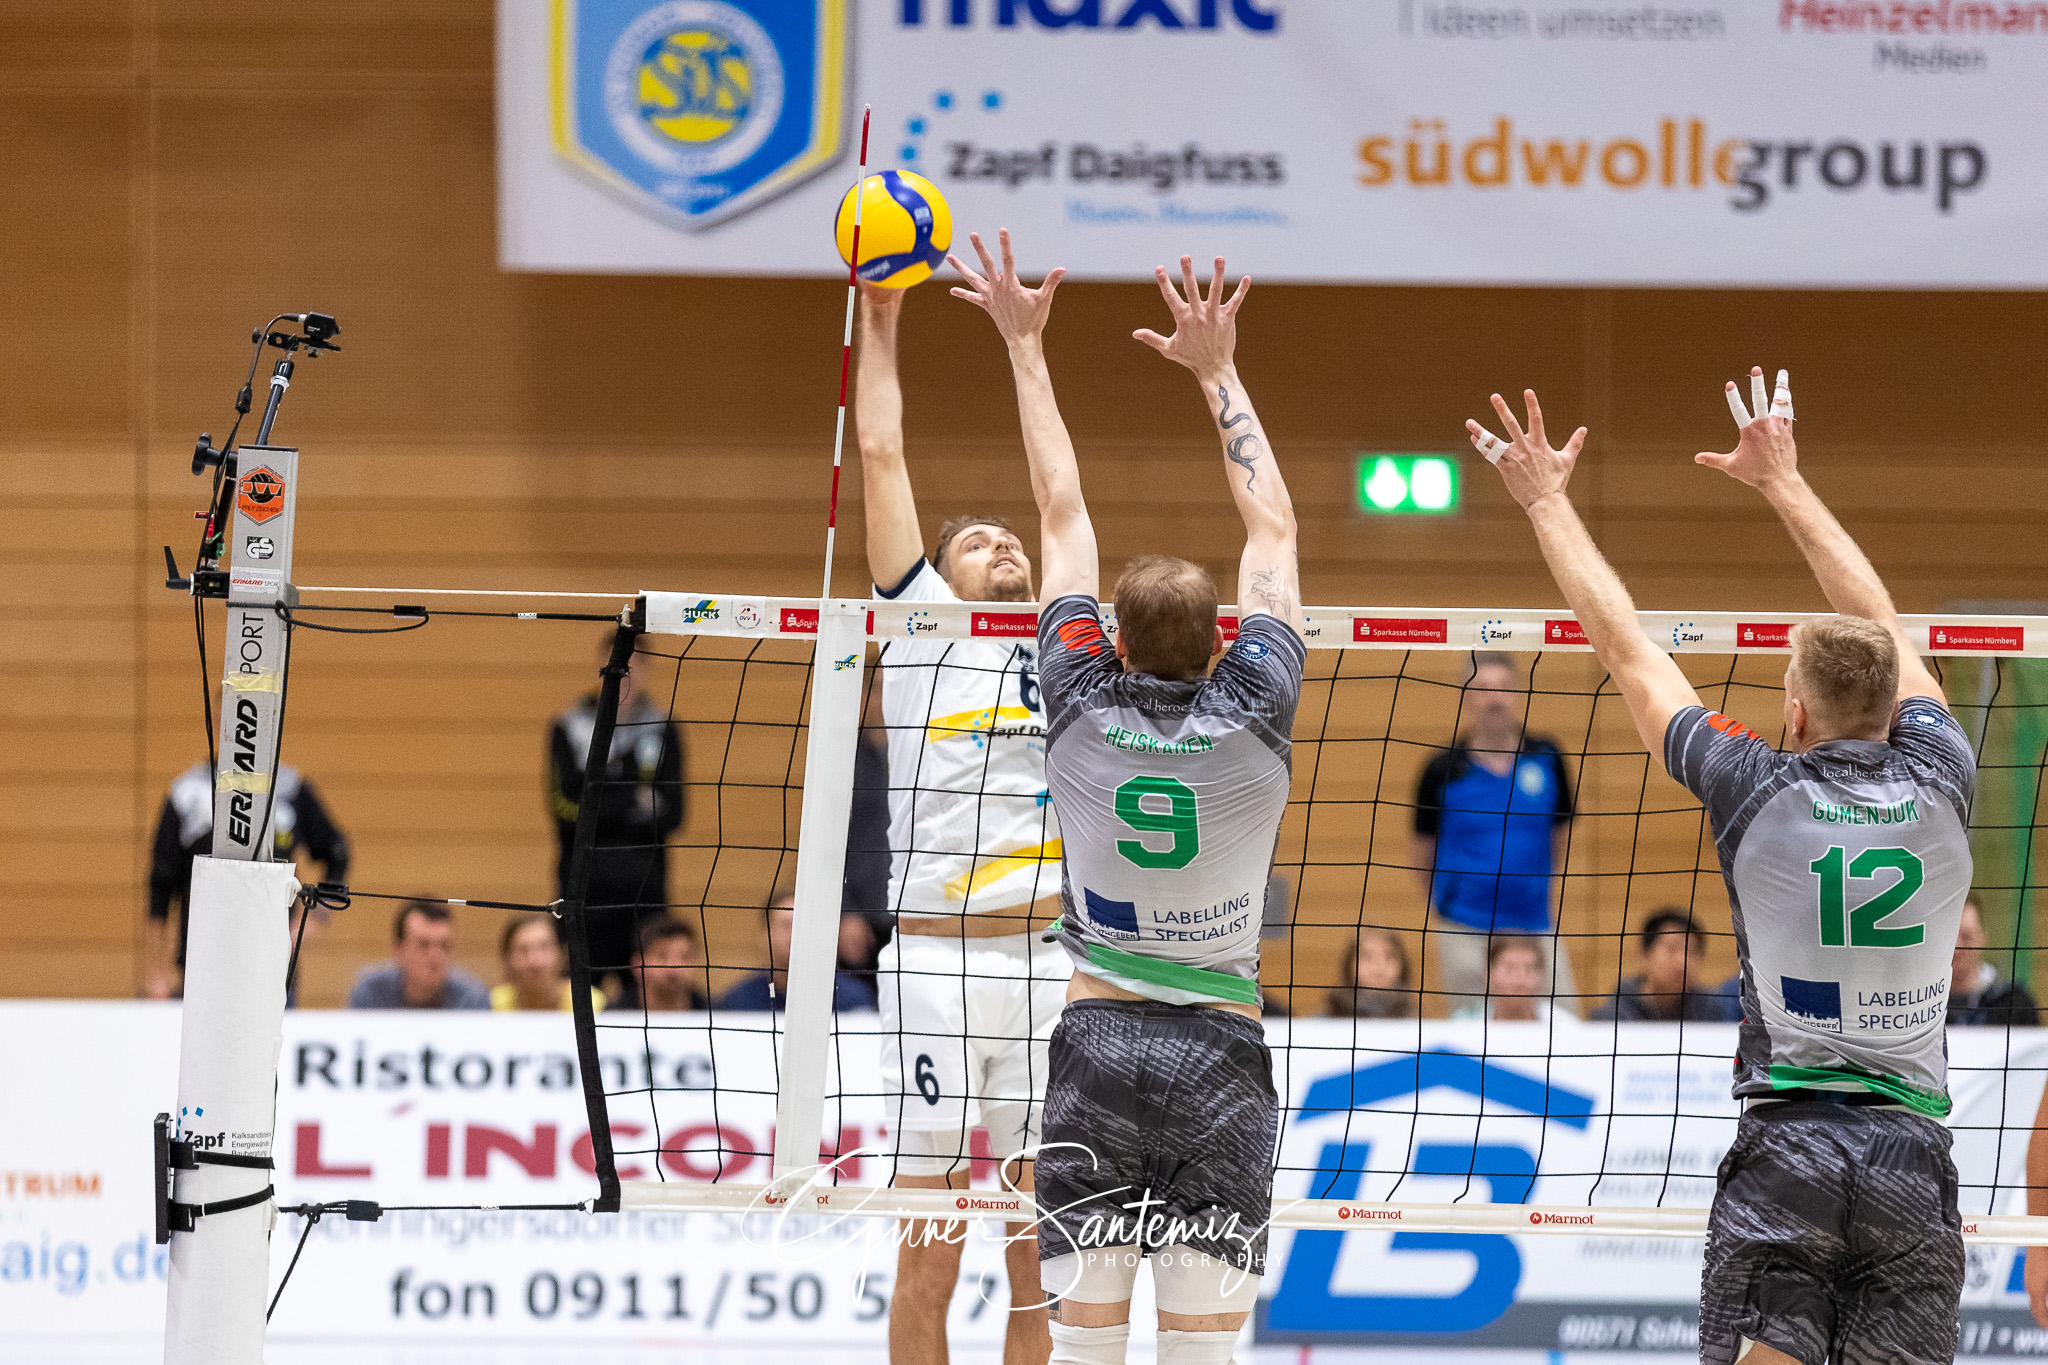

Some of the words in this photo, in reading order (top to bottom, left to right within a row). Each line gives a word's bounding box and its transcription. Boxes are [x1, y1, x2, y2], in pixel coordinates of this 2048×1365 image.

[946, 140, 1057, 193] Zapf
[1069, 140, 1289, 194] Daigfuss
[232, 578, 263, 586] ERHARD
[682, 608, 719, 620] HUCK
[800, 618, 819, 629] Spark
[915, 622, 938, 631] Zapf
[990, 623, 1022, 631] Sparkasse
[1304, 628, 1321, 637] apf
[1373, 628, 1407, 637] Sparkasse
[1408, 629, 1441, 638] Nürnberg
[1490, 630, 1512, 640] Zapf
[1564, 630, 1586, 639] Spark
[1681, 633, 1704, 643] Zapf
[239, 612, 264, 675] PORT
[1949, 636, 1984, 645] Sparkasse
[1984, 637, 2017, 646] Nürnberg
[1104, 724, 1214, 755] HEISKANEN
[228, 698, 258, 847] ERARD
[1112, 773, 1202, 871] 9
[1812, 799, 1921, 826] GUMENJUK
[1808, 844, 1926, 949] 12
[1153, 892, 1250, 925] LABELLING
[1154, 913, 1250, 942] SPECIALIST
[1858, 977, 1945, 1007] LABELLING
[1858, 1000, 1943, 1030] SPECIALIST
[292, 1040, 718, 1092] Ristorante
[915, 1052, 941, 1106] 6
[183, 1130, 226, 1150] Zapf
[0, 1171, 103, 1198] TRUM
[969, 1198, 1021, 1210] Marmot
[1352, 1209, 1402, 1221] Marmot
[1543, 1212, 1594, 1225] Marmot
[391, 1267, 496, 1318] fon
